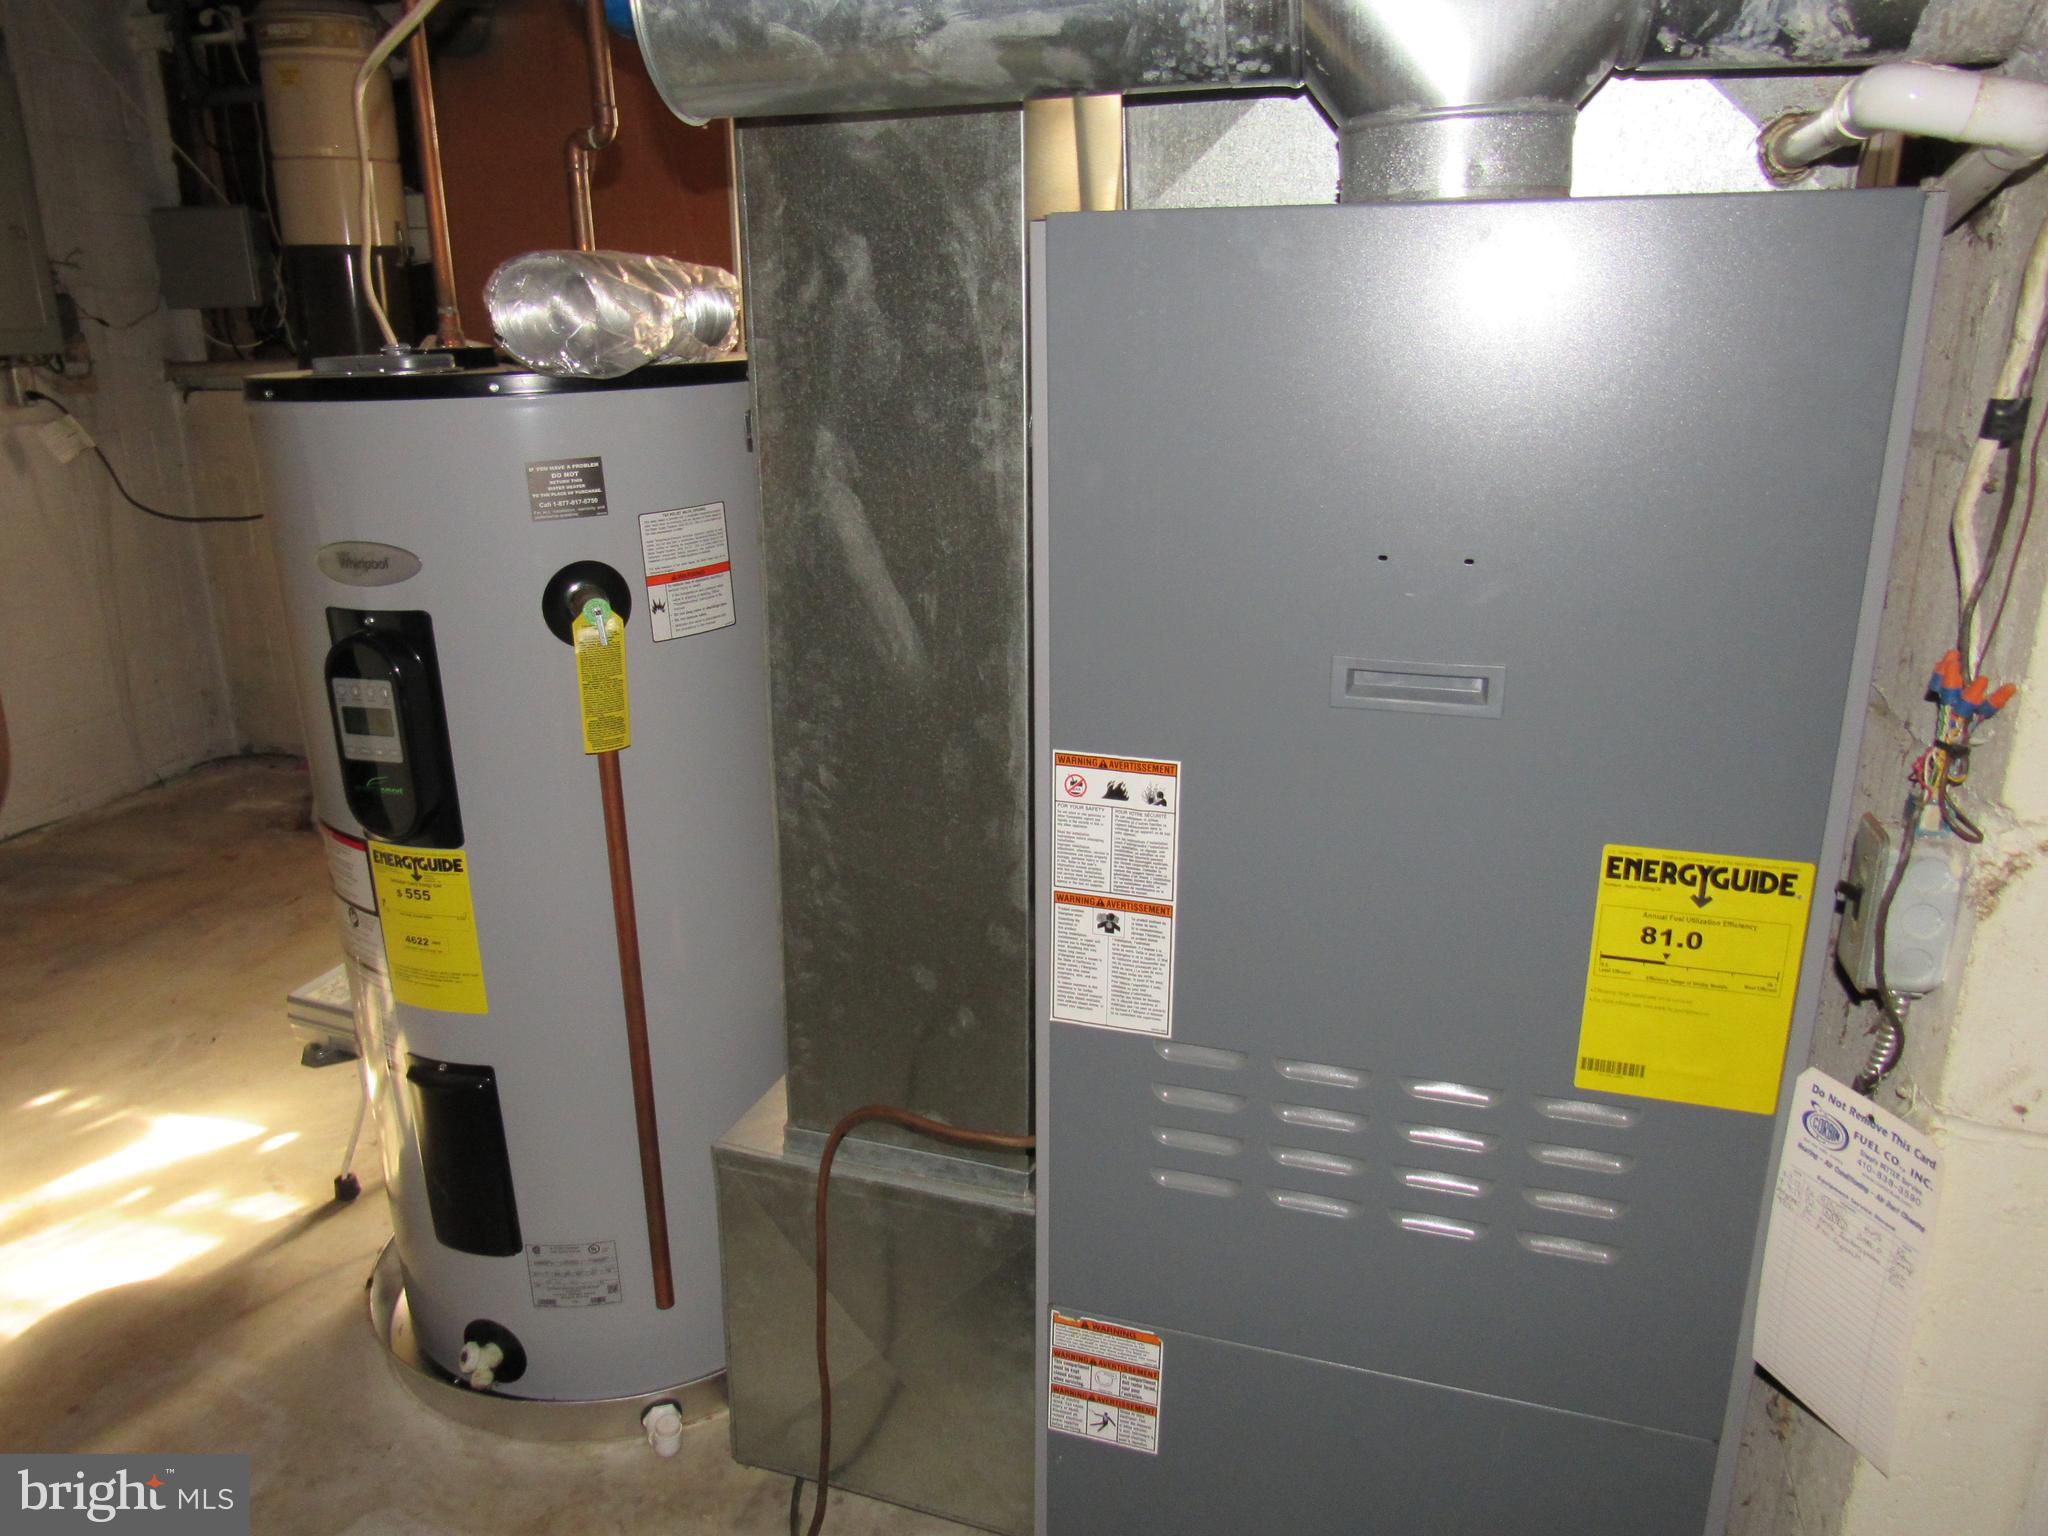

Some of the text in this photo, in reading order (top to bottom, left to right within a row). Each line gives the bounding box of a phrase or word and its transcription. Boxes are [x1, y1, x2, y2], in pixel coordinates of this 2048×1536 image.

[564, 470, 579, 478] NOT
[572, 461, 600, 469] PROBLEM
[1057, 755, 1175, 775] WARNING AVERTISSEMENT
[372, 849, 464, 874] ENERGYGUIDE
[1605, 855, 1798, 898] ENERGYGUIDE
[405, 888, 431, 901] 555
[1056, 892, 1171, 916] WARNING AVERTISSEMENT
[1642, 911, 1758, 932] Annual Fuel Utilization Efficiency
[405, 935, 430, 946] 4622
[1640, 926, 1703, 950] 81.0
[1811, 1084, 1937, 1170] Do Not Remove This Card
[1853, 1131, 1880, 1154] FUEL
[1910, 1167, 1934, 1192] INC.
[1092, 1323, 1137, 1339] WARNING
[1053, 1347, 1157, 1378] WARNING AVERTISSEMENT
[1052, 1385, 1088, 1401] WARNING
[1096, 1395, 1156, 1416] AVERTISSEMENT
